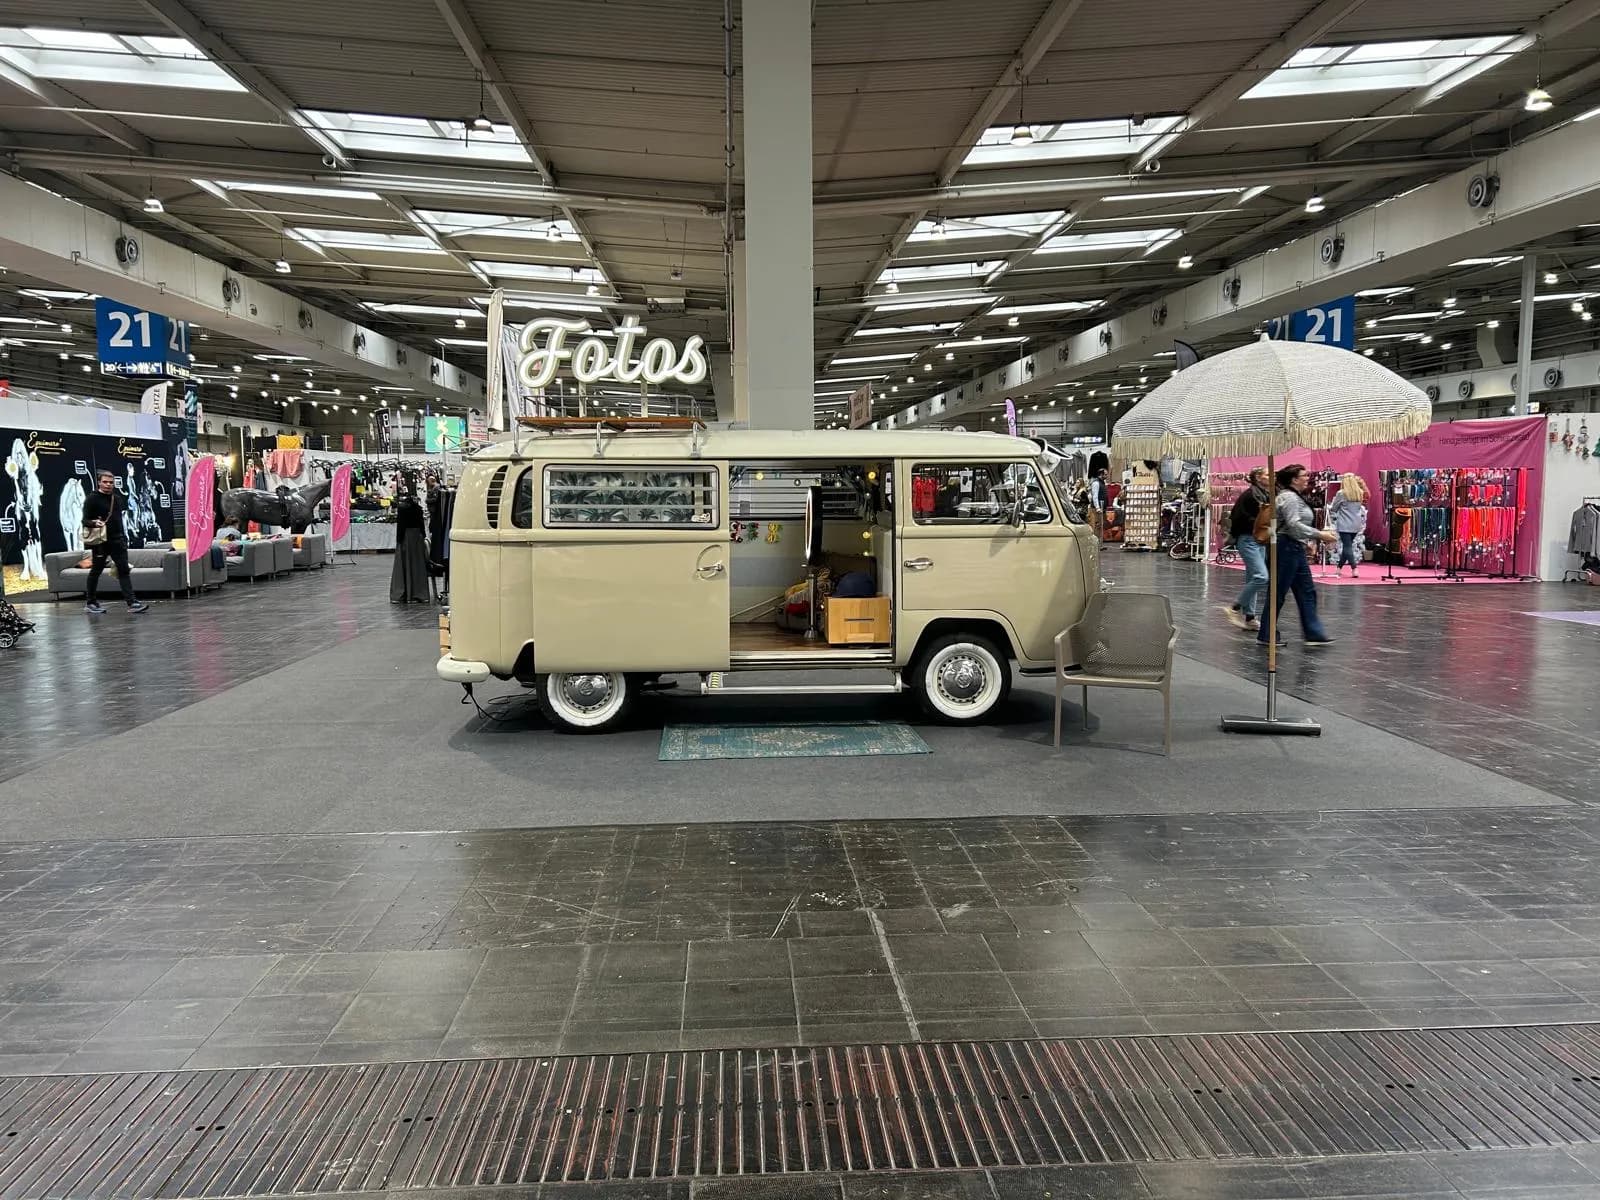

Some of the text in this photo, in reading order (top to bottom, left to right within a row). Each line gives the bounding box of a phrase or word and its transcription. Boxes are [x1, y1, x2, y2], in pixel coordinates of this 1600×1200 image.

[108, 311, 151, 347] 21
[168, 316, 186, 353] 21
[1305, 308, 1342, 342] 21
[518, 314, 707, 388] Fotos
